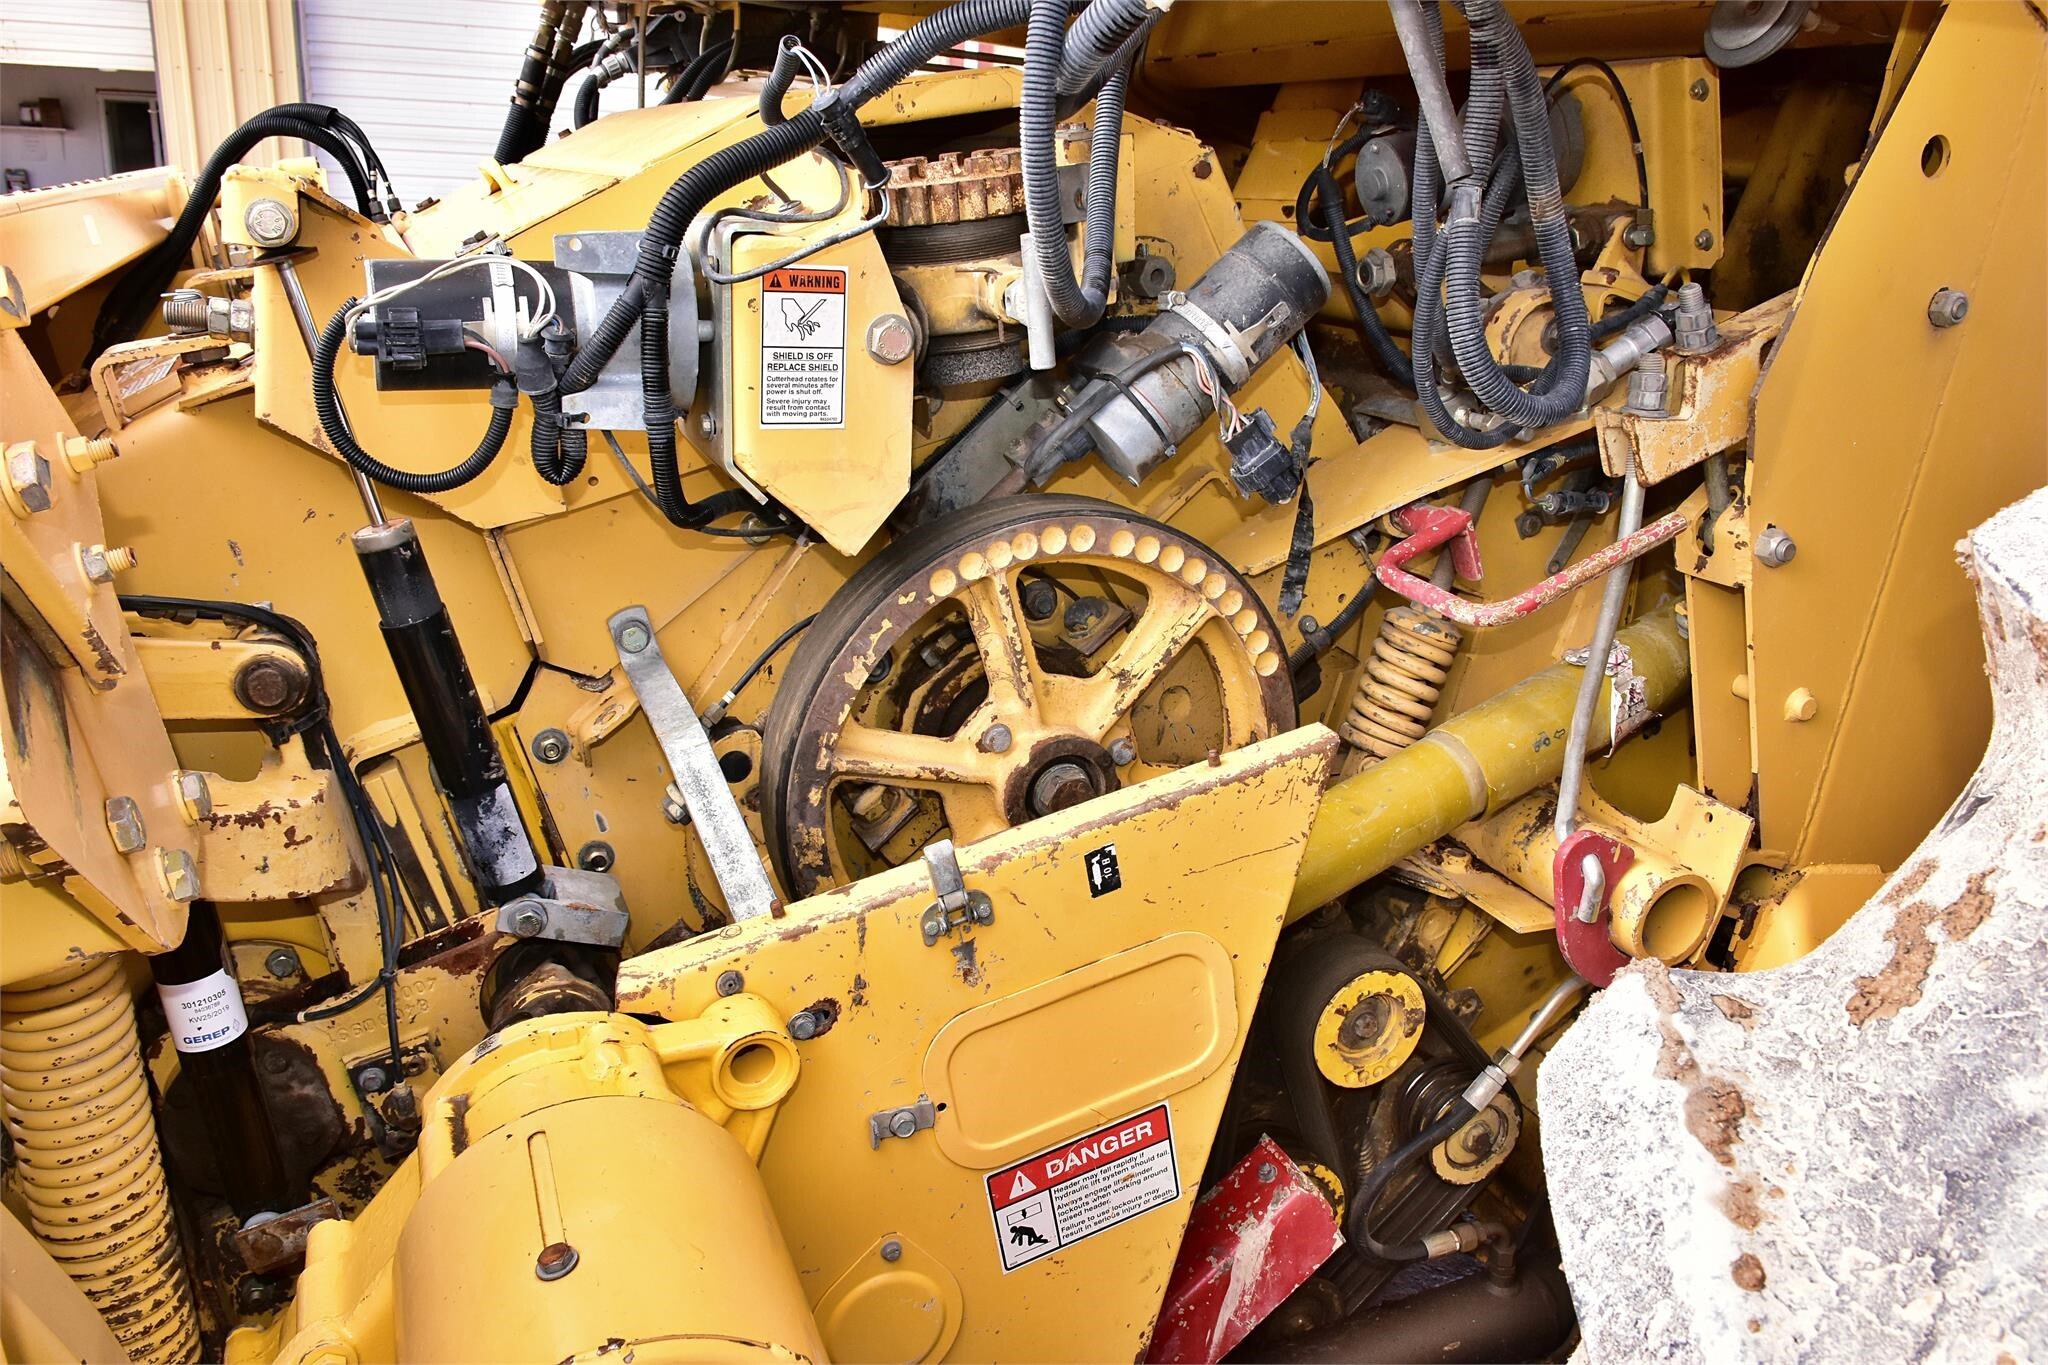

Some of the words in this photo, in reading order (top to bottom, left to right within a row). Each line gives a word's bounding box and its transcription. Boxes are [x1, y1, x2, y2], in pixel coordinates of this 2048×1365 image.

[789, 274, 840, 288] WARNING
[772, 352, 803, 360] SHIELD
[1104, 867, 1112, 879] 10
[182, 989, 226, 1009] 301210305
[189, 1004, 230, 1023] KW25/2019
[184, 1026, 230, 1044] GEREP
[1045, 1121, 1152, 1178] DANGER
[1054, 1180, 1080, 1194] Header
[1082, 1173, 1098, 1183] may
[1100, 1166, 1112, 1175] fall
[1113, 1156, 1137, 1170] rapidly
[1055, 1184, 1088, 1202] hydraulic
[1103, 1167, 1129, 1181] system
[1130, 1155, 1155, 1169] should
[1156, 1150, 1170, 1158] fail.
[1057, 1197, 1082, 1210] Always
[1084, 1184, 1112, 1198] engage
[1058, 1201, 1090, 1217] lockouts
[1092, 1191, 1111, 1203] when
[1113, 1179, 1141, 1194] working
[1143, 1166, 1168, 1181] around
[1060, 1210, 1082, 1224] raised
[1084, 1200, 1111, 1213] header.
[1061, 1219, 1085, 1233] Failure
[1111, 1196, 1142, 1211] lockouts
[1144, 1188, 1160, 1197] may
[1062, 1227, 1083, 1240] result
[1094, 1212, 1120, 1226] serious
[1122, 1203, 1142, 1214] injury
[1152, 1189, 1174, 1201] death.
